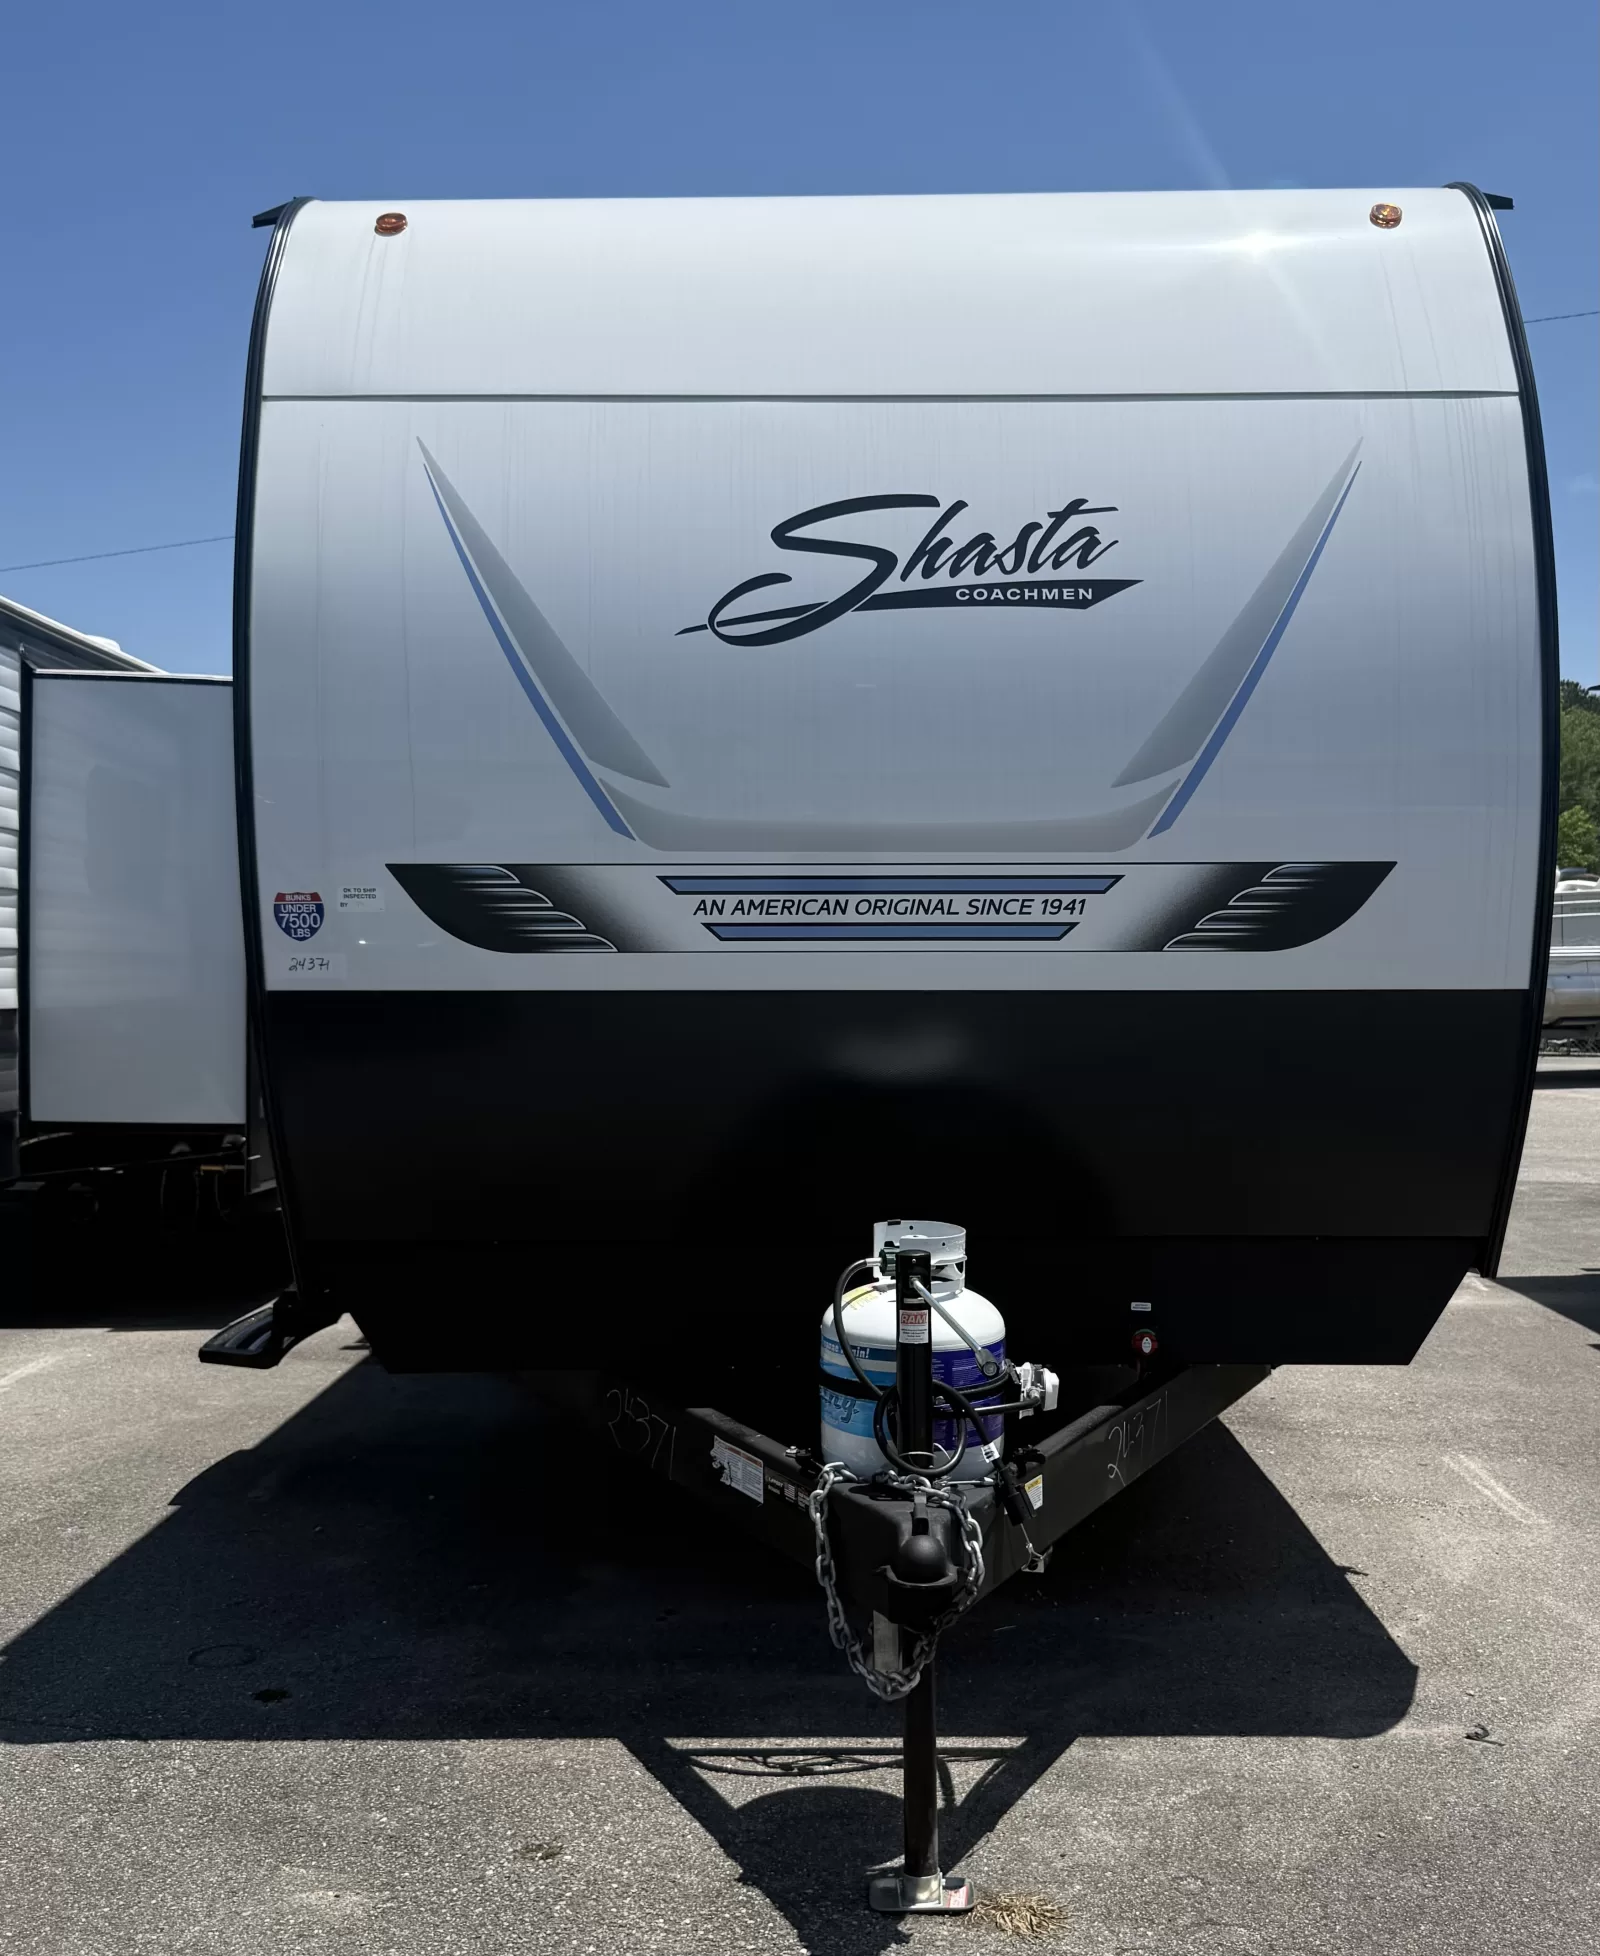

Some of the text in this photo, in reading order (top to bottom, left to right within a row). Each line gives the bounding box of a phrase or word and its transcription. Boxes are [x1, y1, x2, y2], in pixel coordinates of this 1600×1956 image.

[707, 493, 1119, 648] Shasta
[954, 587, 1095, 601] COACHMEN
[285, 894, 312, 902] BUNKS
[280, 904, 317, 913] UNDER
[693, 897, 1087, 916] AN AMERICAN ORIGINAL SINCE 1941
[278, 913, 321, 929] 7500
[291, 928, 311, 938] LBS
[901, 1314, 927, 1325] RAM
